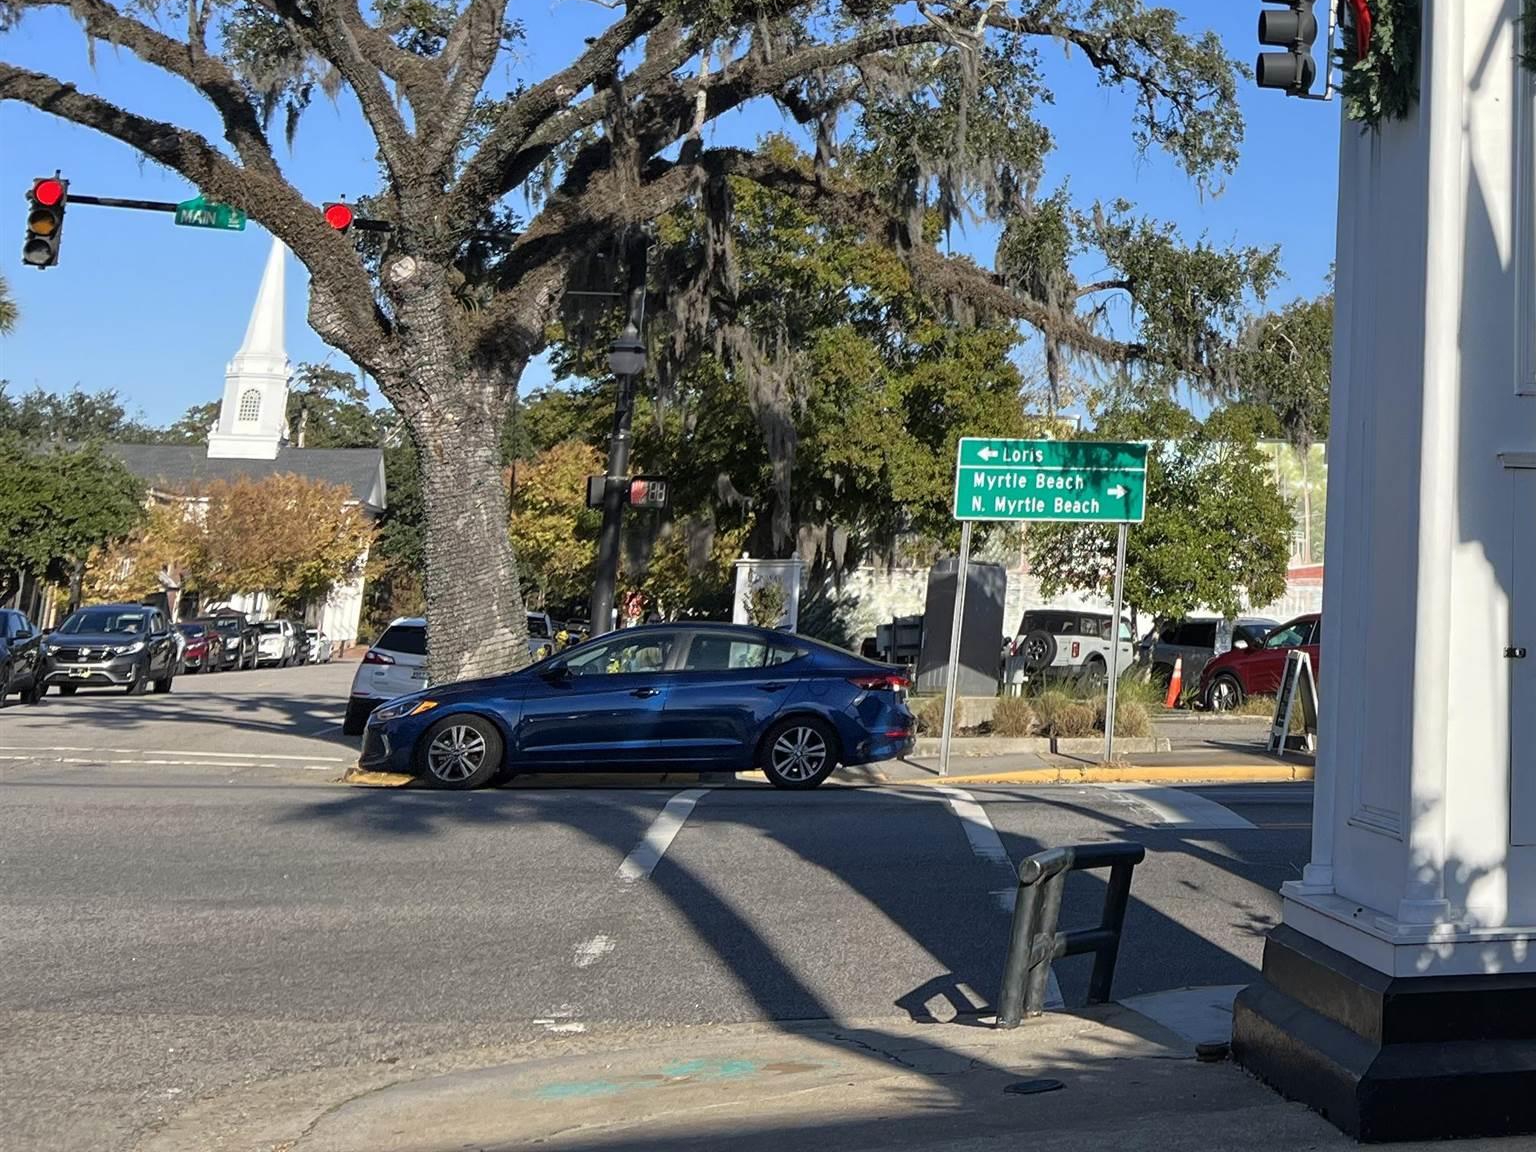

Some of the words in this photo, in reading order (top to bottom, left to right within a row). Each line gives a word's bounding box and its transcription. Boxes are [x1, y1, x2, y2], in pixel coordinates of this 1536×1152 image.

[180, 209, 217, 225] MAIN
[1003, 447, 1044, 463] Loris
[973, 472, 1027, 491] Myrtle
[1036, 474, 1084, 490] Beach
[971, 496, 986, 513] N.
[994, 497, 1045, 515] Myrtle
[1054, 498, 1100, 513] Beach
